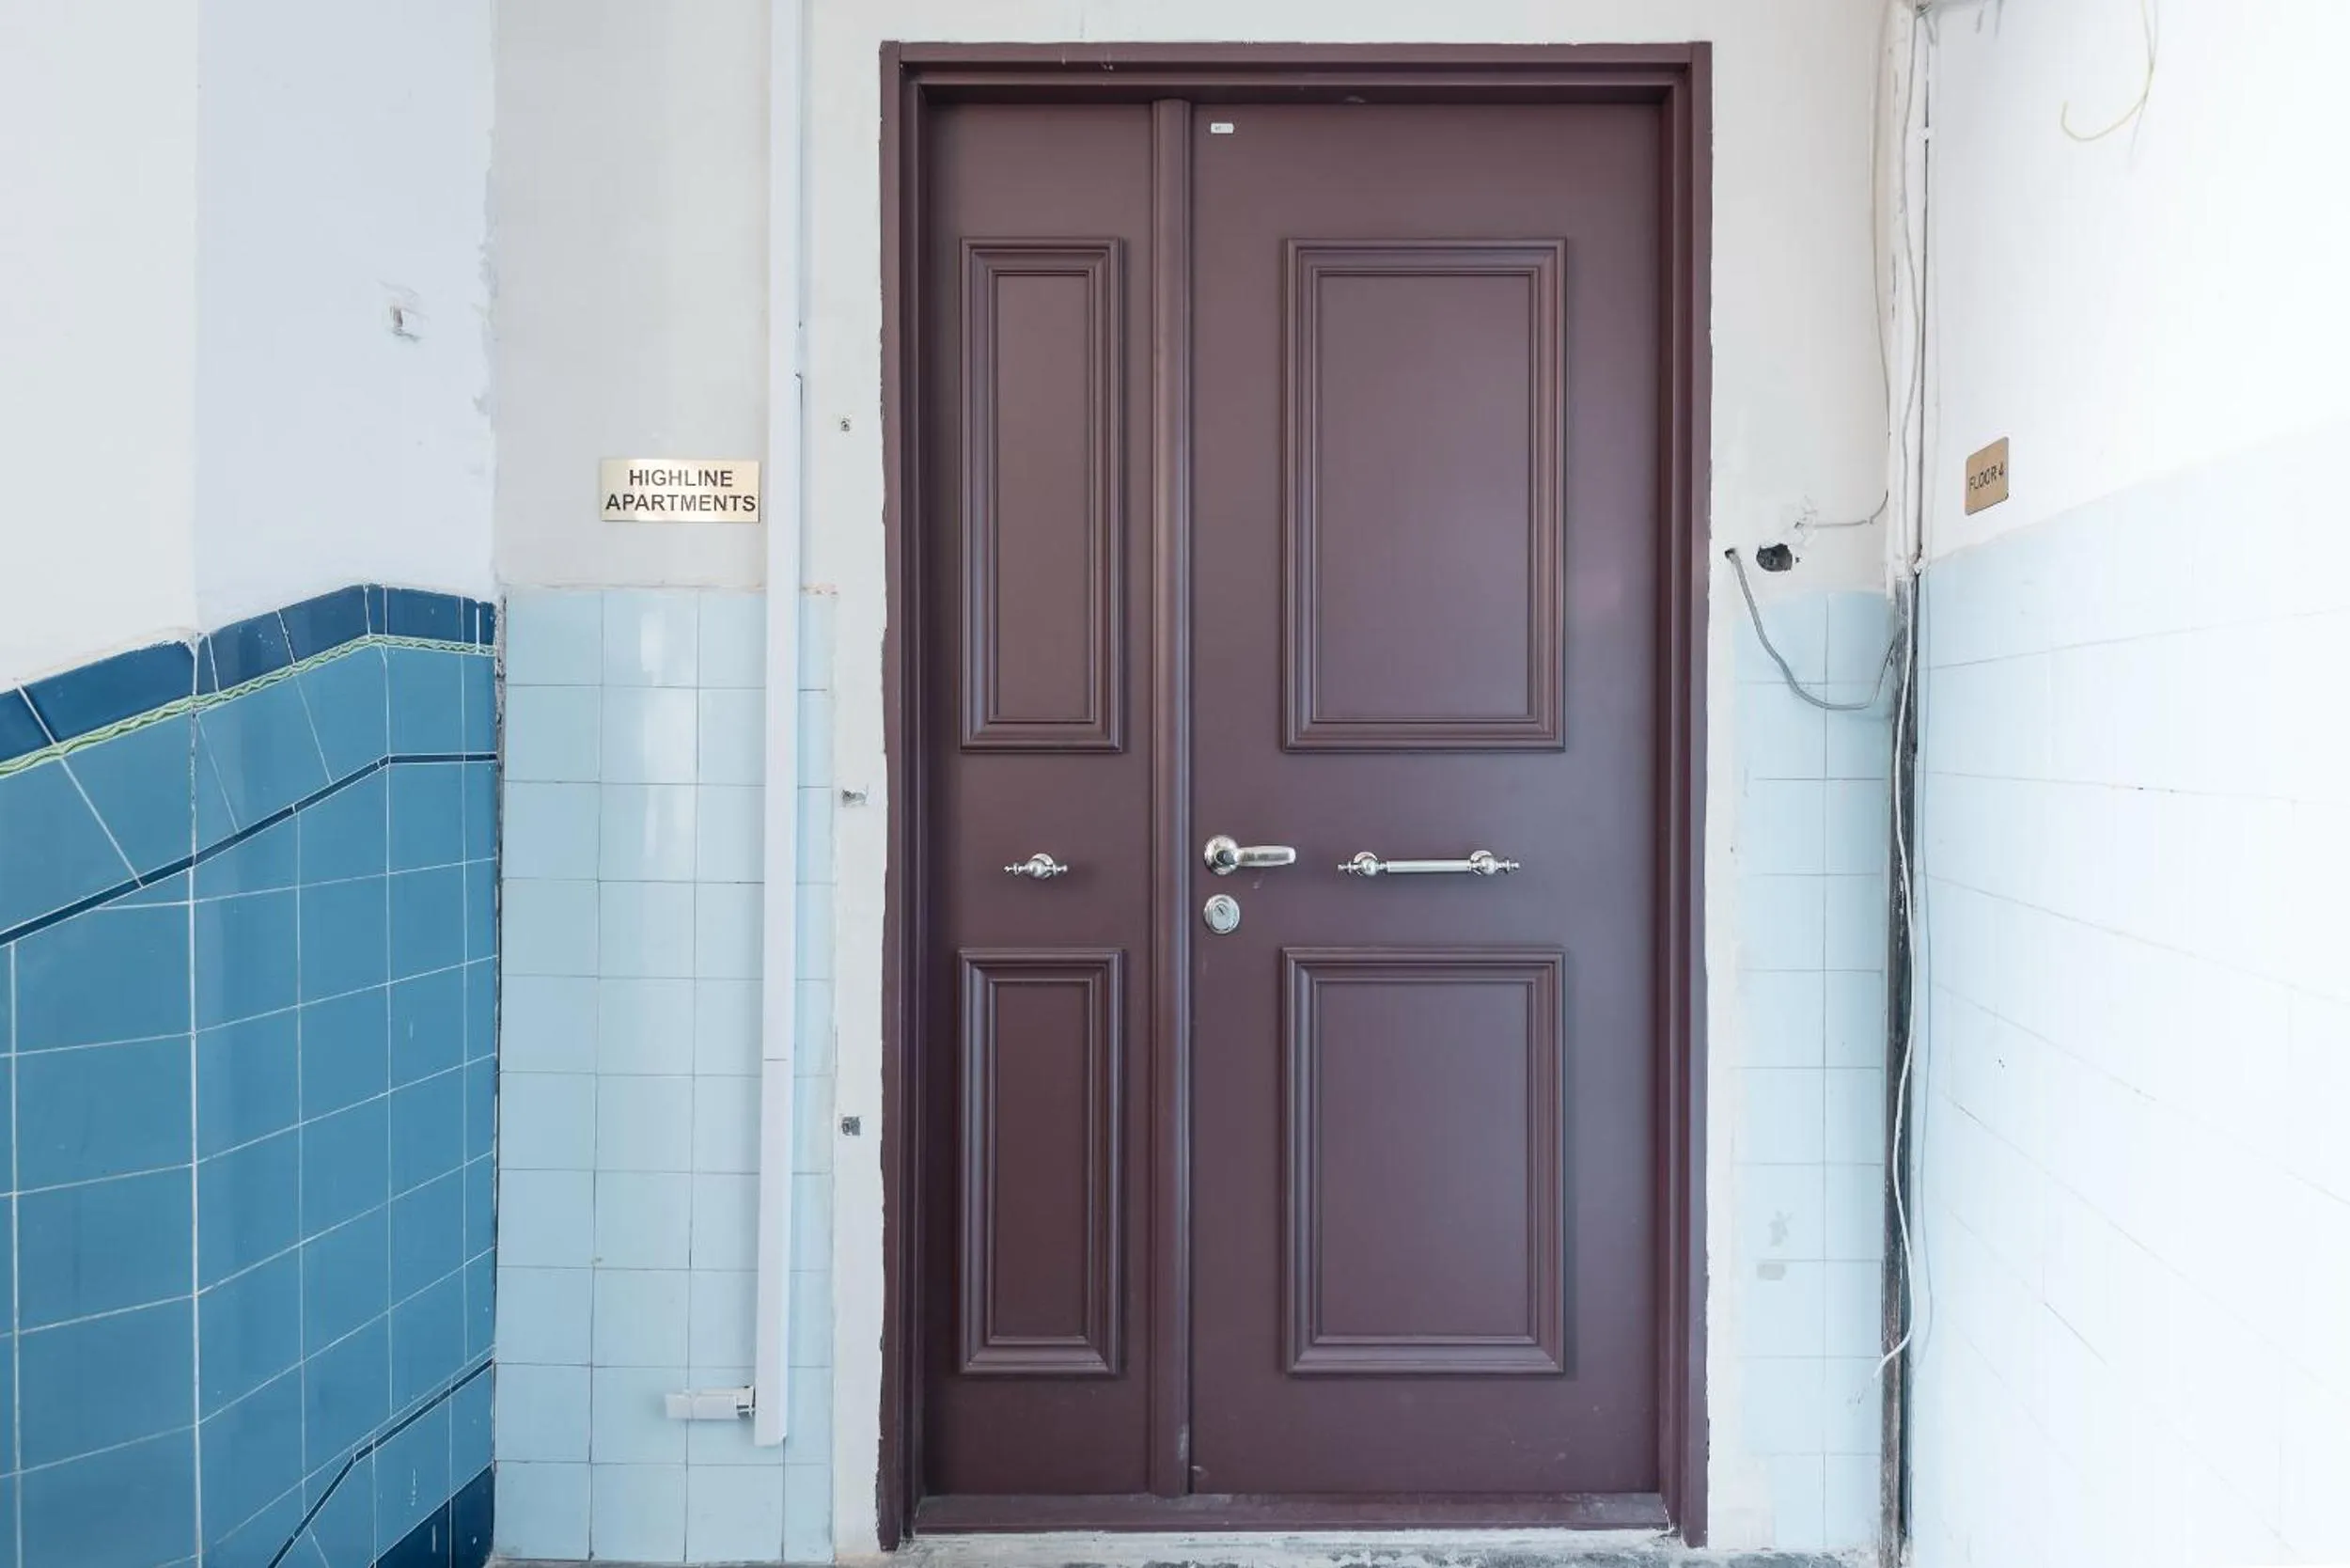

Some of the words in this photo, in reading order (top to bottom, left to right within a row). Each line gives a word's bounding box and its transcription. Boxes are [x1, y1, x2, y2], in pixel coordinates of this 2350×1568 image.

[629, 469, 733, 487] HIGHLINE
[1969, 464, 1997, 491] FLOOR
[605, 494, 756, 511] APARTMENTS
